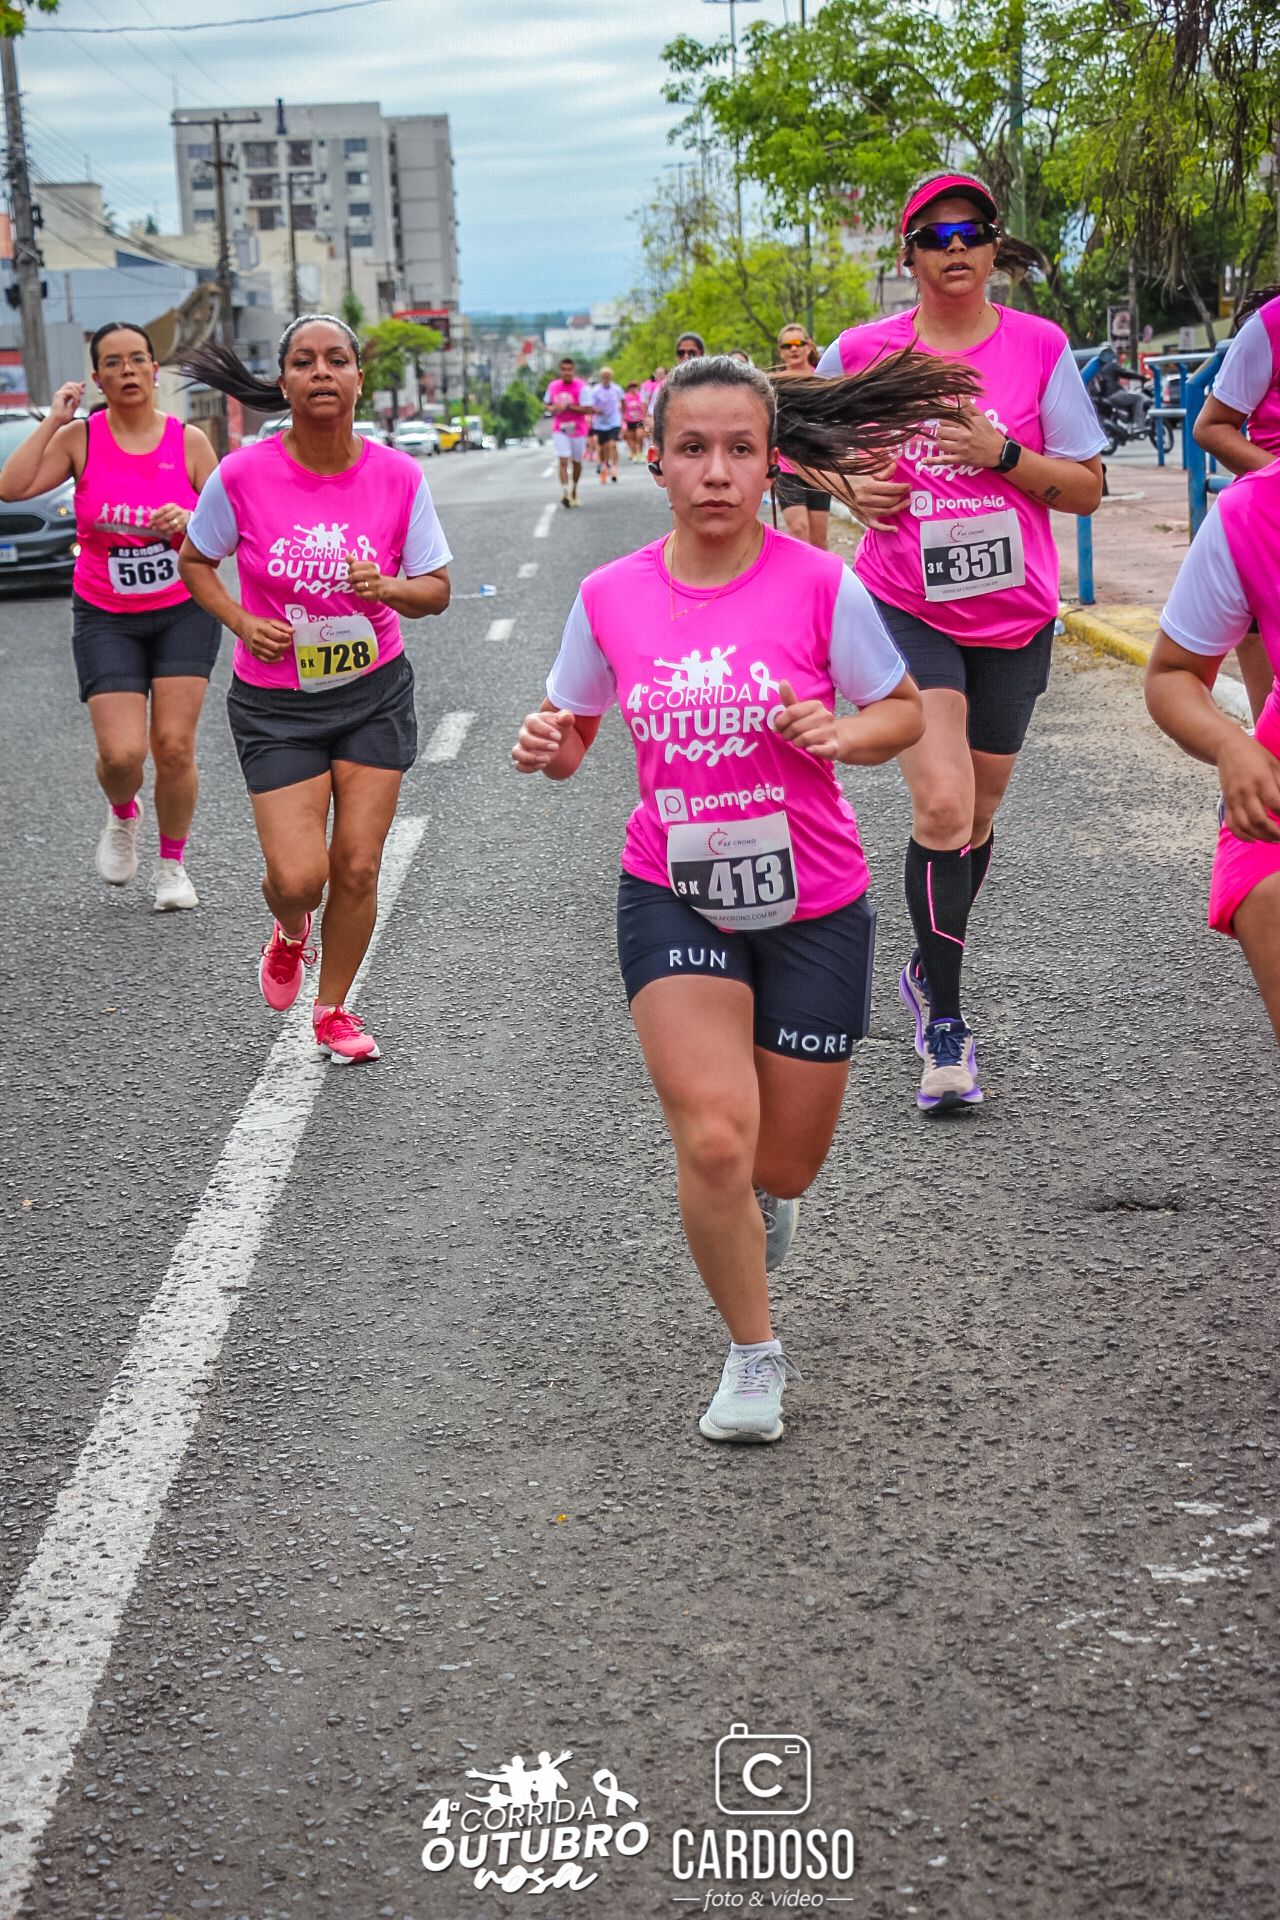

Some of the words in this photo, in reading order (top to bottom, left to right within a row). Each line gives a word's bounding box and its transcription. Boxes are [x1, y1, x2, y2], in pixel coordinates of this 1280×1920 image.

[936, 494, 1006, 512] pompéia
[289, 545, 359, 560] CORRIDA
[948, 541, 1006, 582] 351
[117, 558, 174, 586] 563
[293, 579, 355, 599] rosa
[317, 641, 371, 675] 728
[648, 683, 753, 711] CORRIDA
[664, 736, 759, 767] rosa
[690, 783, 785, 817] pompéia
[708, 854, 785, 907] 413
[669, 948, 726, 970] RUN
[778, 1028, 847, 1054] MORE
